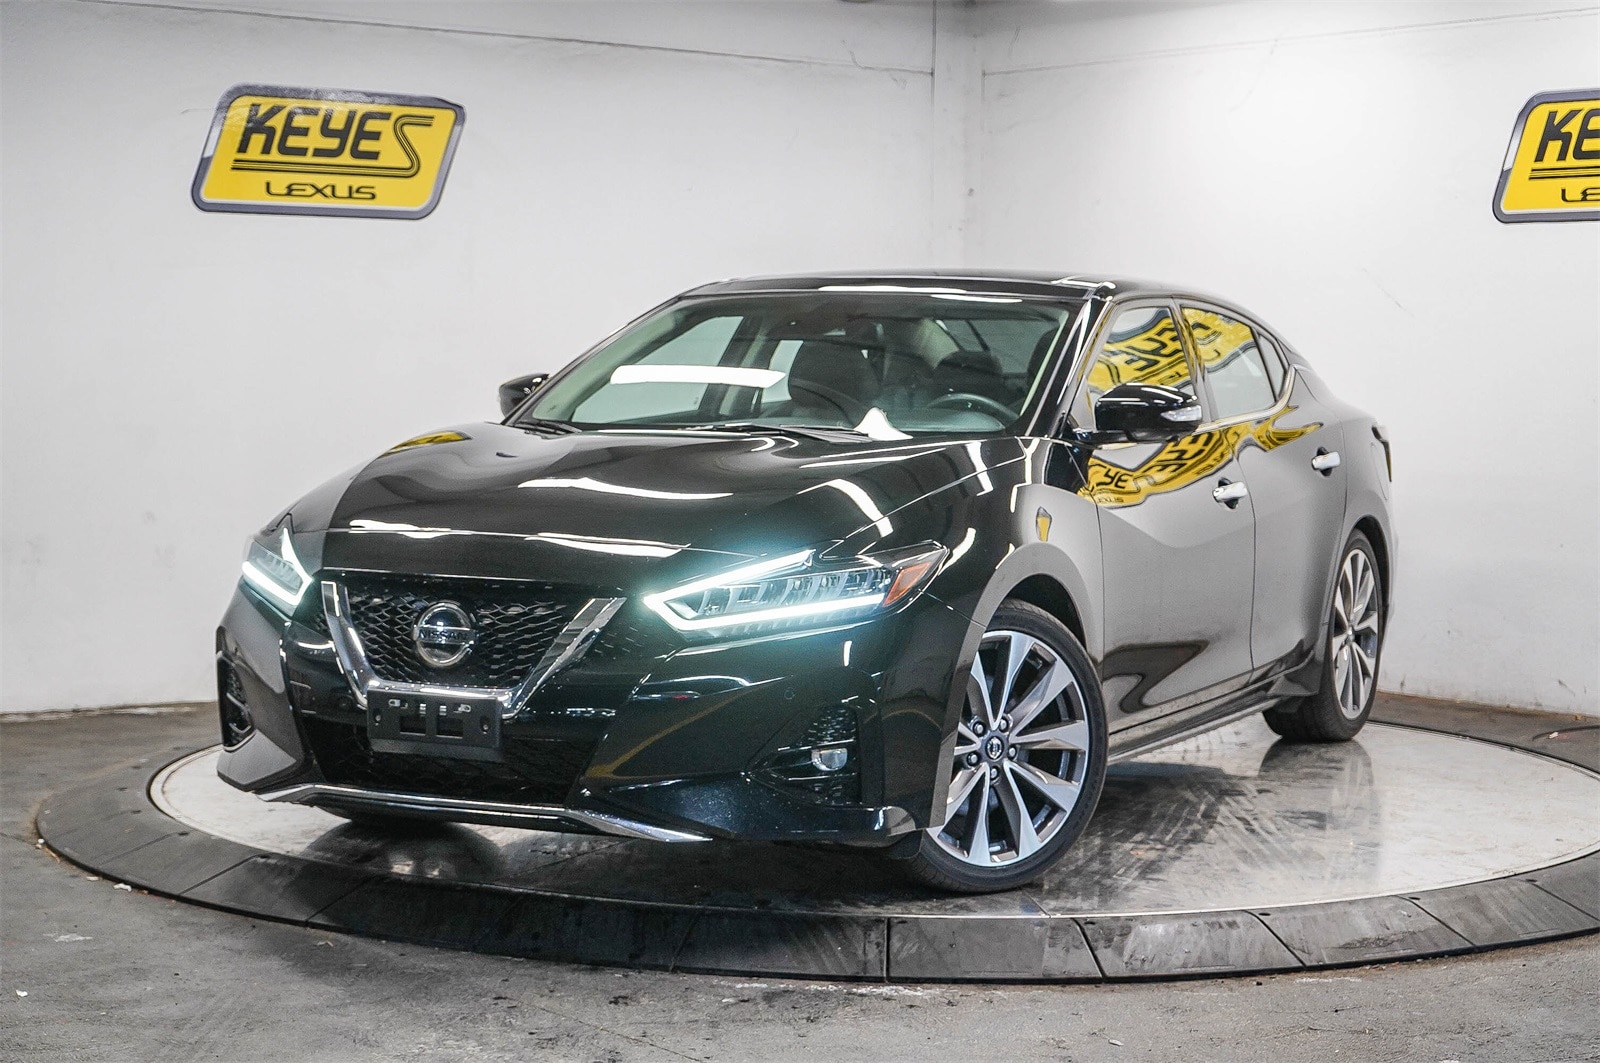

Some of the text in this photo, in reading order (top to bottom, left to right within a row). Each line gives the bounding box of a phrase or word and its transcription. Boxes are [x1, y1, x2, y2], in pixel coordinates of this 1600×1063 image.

[231, 103, 435, 178] KEYES
[265, 181, 376, 200] LEXUS
[418, 629, 469, 640] NISSAN
